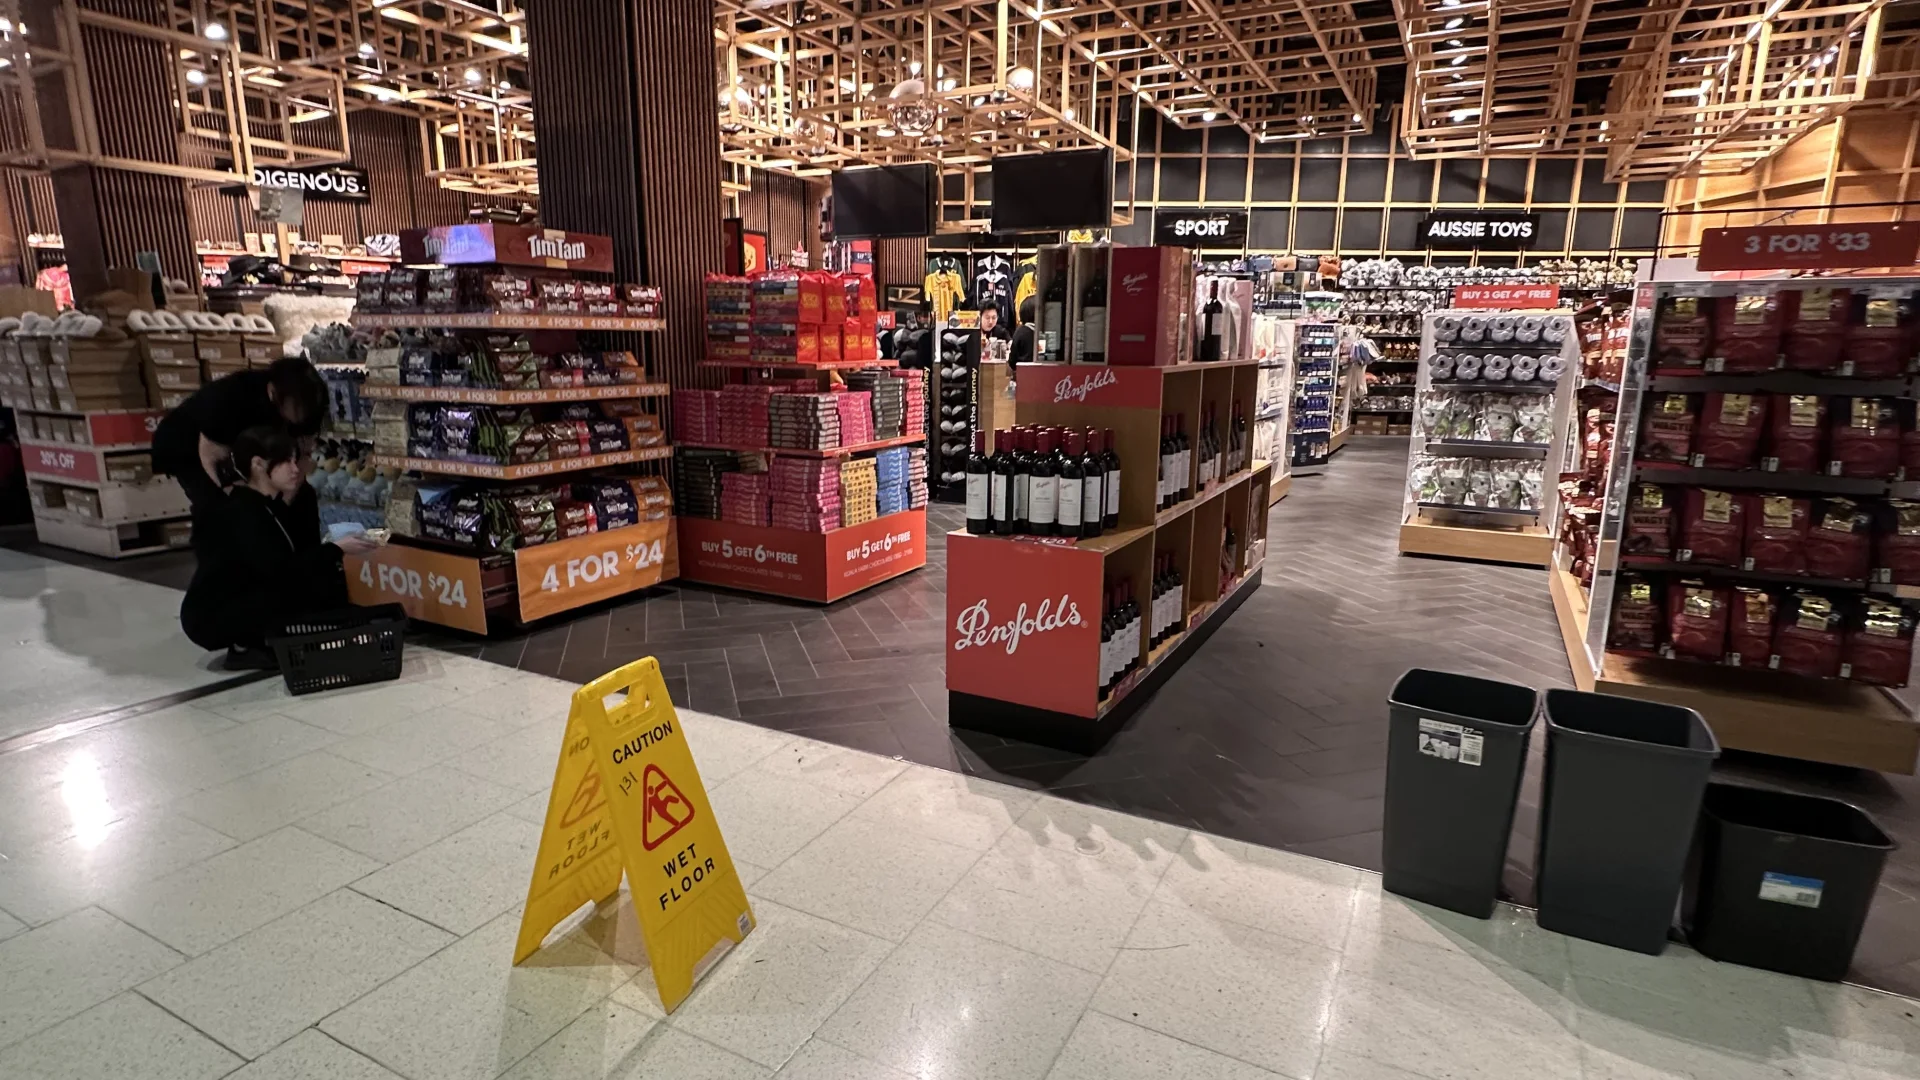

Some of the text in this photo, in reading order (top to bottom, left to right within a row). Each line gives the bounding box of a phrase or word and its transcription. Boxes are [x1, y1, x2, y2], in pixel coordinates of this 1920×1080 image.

[228, 168, 360, 193] DIGENOUS
[1174, 219, 1229, 237] SPORT
[1429, 221, 1533, 238] AUSSIE TOYS
[1744, 231, 1871, 254] 3 FOR $33
[1461, 290, 1482, 300] BUY
[1482, 290, 1490, 299] 3
[1491, 290, 1511, 299] GET
[1528, 289, 1552, 299] FREE
[970, 368, 978, 405] journey
[1053, 368, 1117, 403] Penfolds
[144, 416, 164, 432] 3
[40, 450, 75, 469] 30% OFF
[701, 540, 720, 553] BUY
[721, 539, 734, 558] 5
[734, 545, 754, 558] GET
[775, 552, 798, 565] FREE
[846, 547, 861, 562] BUY
[861, 539, 871, 559] 5
[871, 540, 884, 554] GET
[897, 530, 911, 545] FREE
[542, 539, 664, 593] 4 FOR $24
[359, 560, 467, 609] 4 FOR $24
[954, 594, 1082, 655] Penfolds
[612, 720, 673, 764] CAUTION
[618, 771, 639, 796] 131
[662, 843, 697, 879] WET
[659, 859, 716, 911] FLOOR
